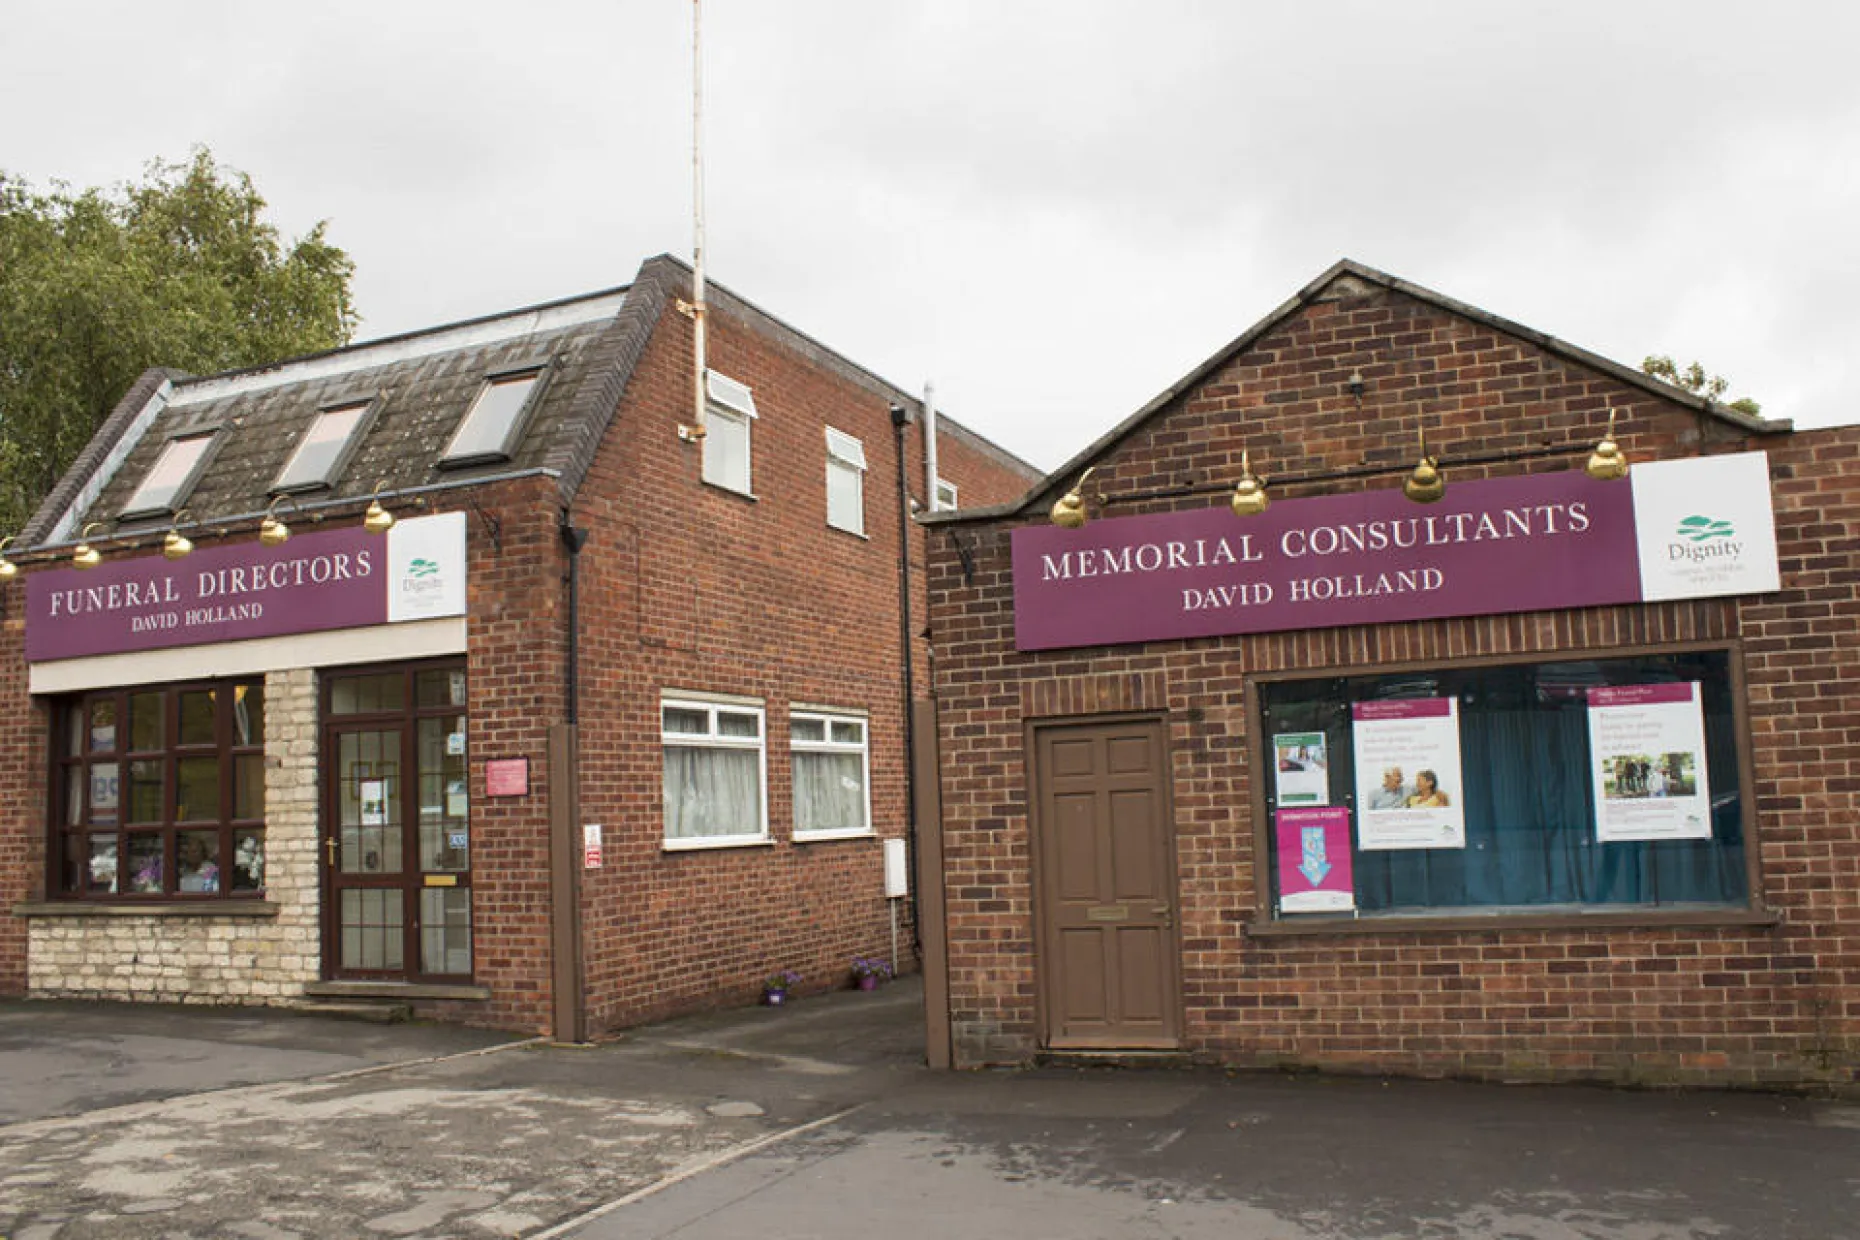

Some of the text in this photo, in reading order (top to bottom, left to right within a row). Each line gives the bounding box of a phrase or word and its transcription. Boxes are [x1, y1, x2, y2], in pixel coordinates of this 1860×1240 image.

[1042, 504, 1589, 580] MEMORIAL CONSULTANTS
[1668, 541, 1743, 562] Dignity
[51, 552, 371, 615] FUNERAL DIRECTORS
[1183, 568, 1442, 611] DAVID HOLLAND
[132, 603, 262, 632] DAVID HOLLAND
